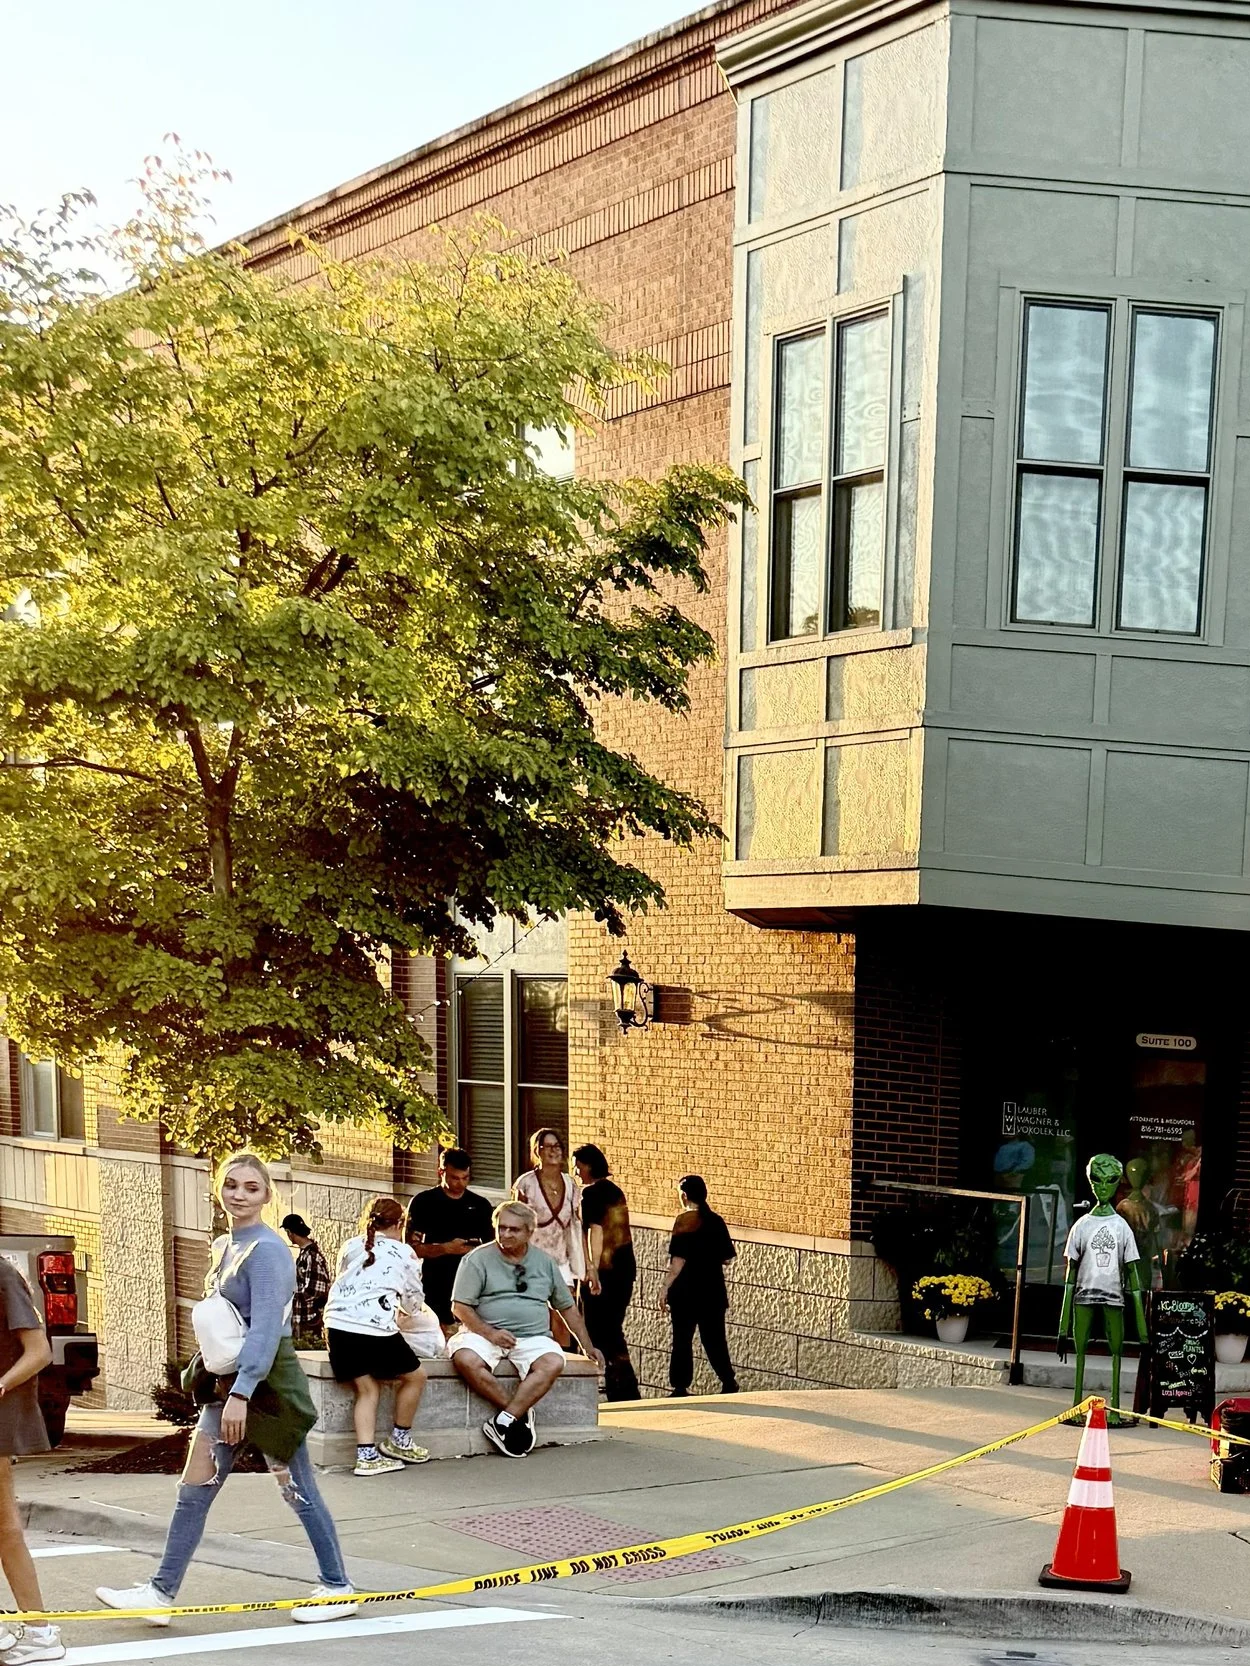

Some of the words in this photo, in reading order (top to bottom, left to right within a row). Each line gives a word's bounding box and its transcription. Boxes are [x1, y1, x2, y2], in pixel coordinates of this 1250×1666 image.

[1142, 1036, 1170, 1046] SUITE
[1174, 1038, 1192, 1047] 100
[1017, 1116, 1052, 1126] WAGNER
[474, 1572, 521, 1591] POLICE
[570, 1560, 590, 1576] DO
[592, 1554, 618, 1570] NOT
[622, 1546, 666, 1565] CROSS
